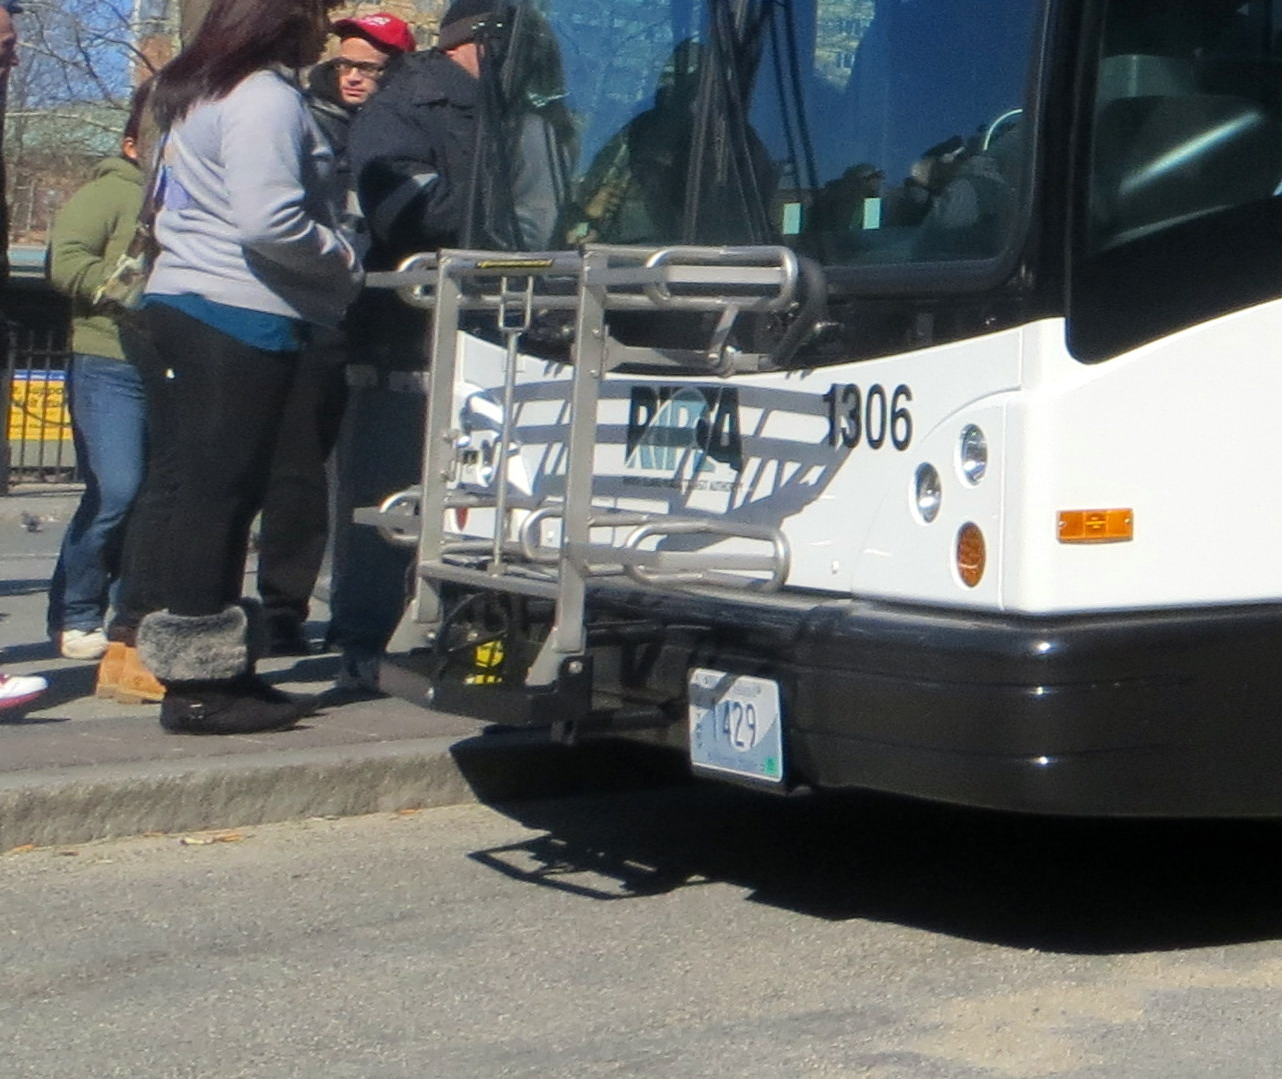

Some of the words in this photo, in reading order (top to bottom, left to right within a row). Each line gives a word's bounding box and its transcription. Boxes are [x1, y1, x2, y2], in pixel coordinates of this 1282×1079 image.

[624, 386, 743, 473] RIPTA
[823, 383, 913, 451] 1306
[712, 697, 757, 750] 1429
